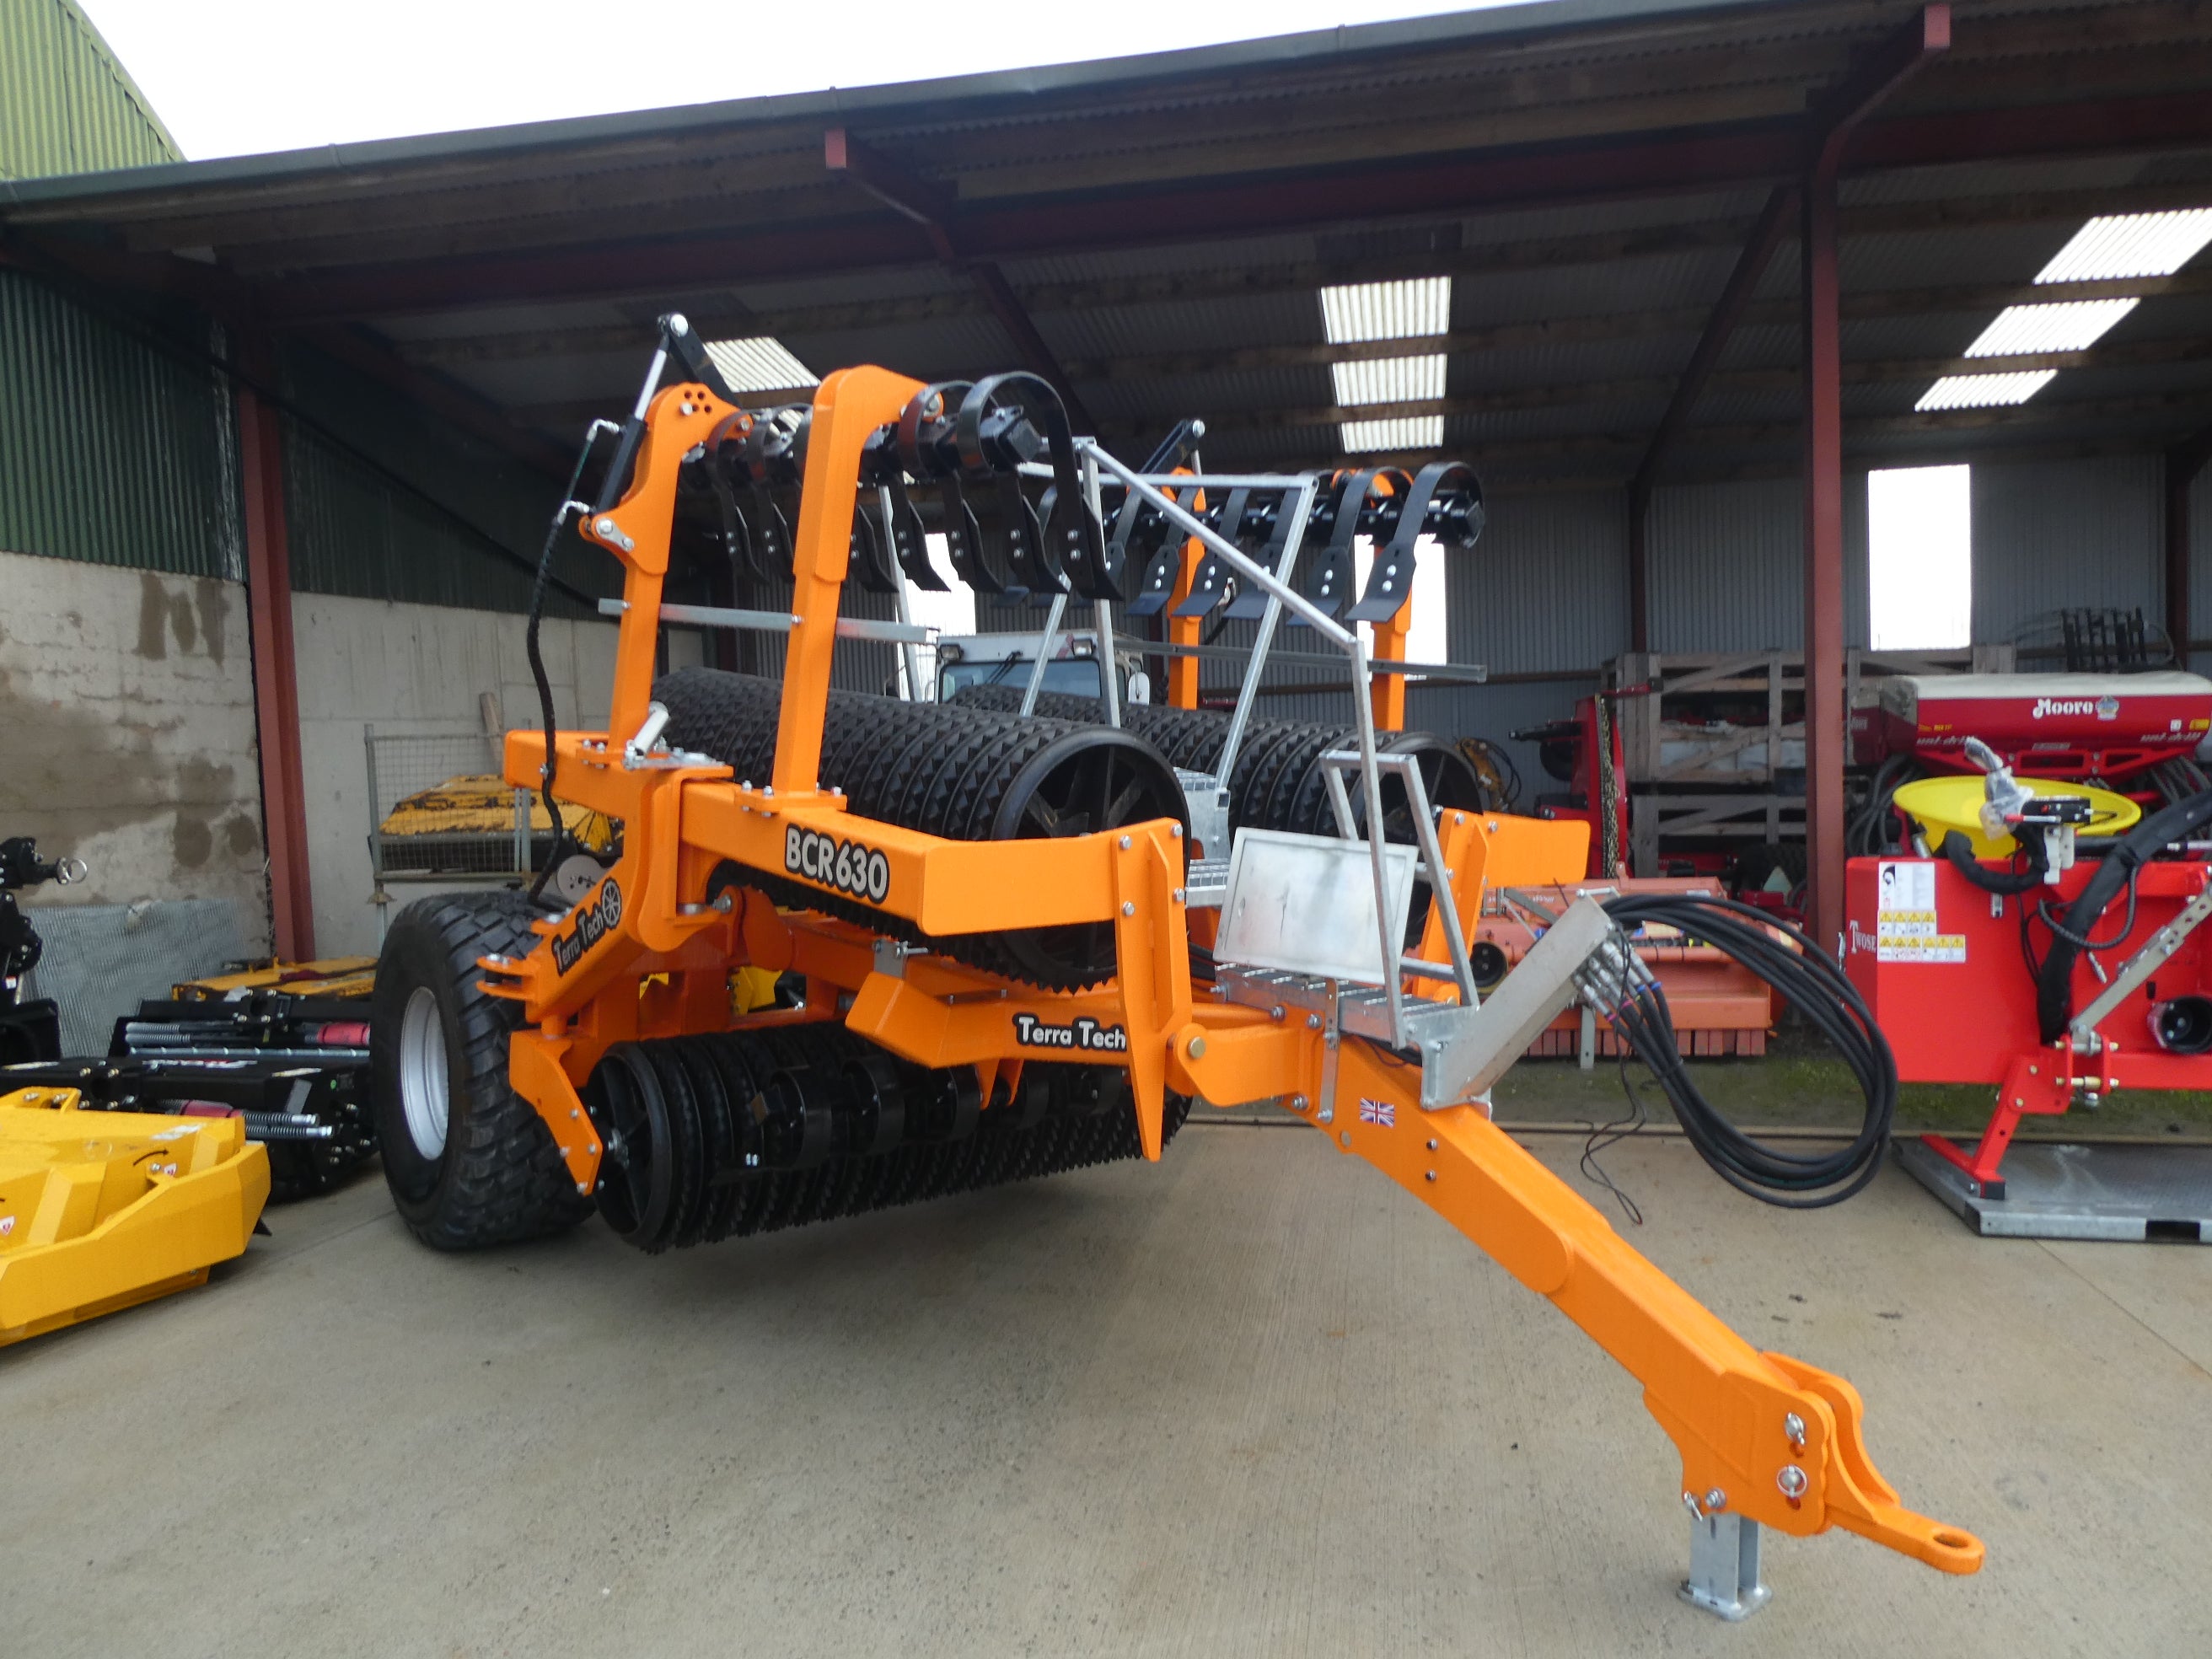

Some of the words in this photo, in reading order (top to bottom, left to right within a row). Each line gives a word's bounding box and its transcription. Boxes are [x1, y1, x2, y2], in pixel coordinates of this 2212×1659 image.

[785, 826, 889, 900] BCR630
[553, 935, 582, 971] Terra
[577, 907, 604, 945] Tech
[1018, 1016, 1072, 1045] Terra
[1078, 1020, 1126, 1050] Tech
